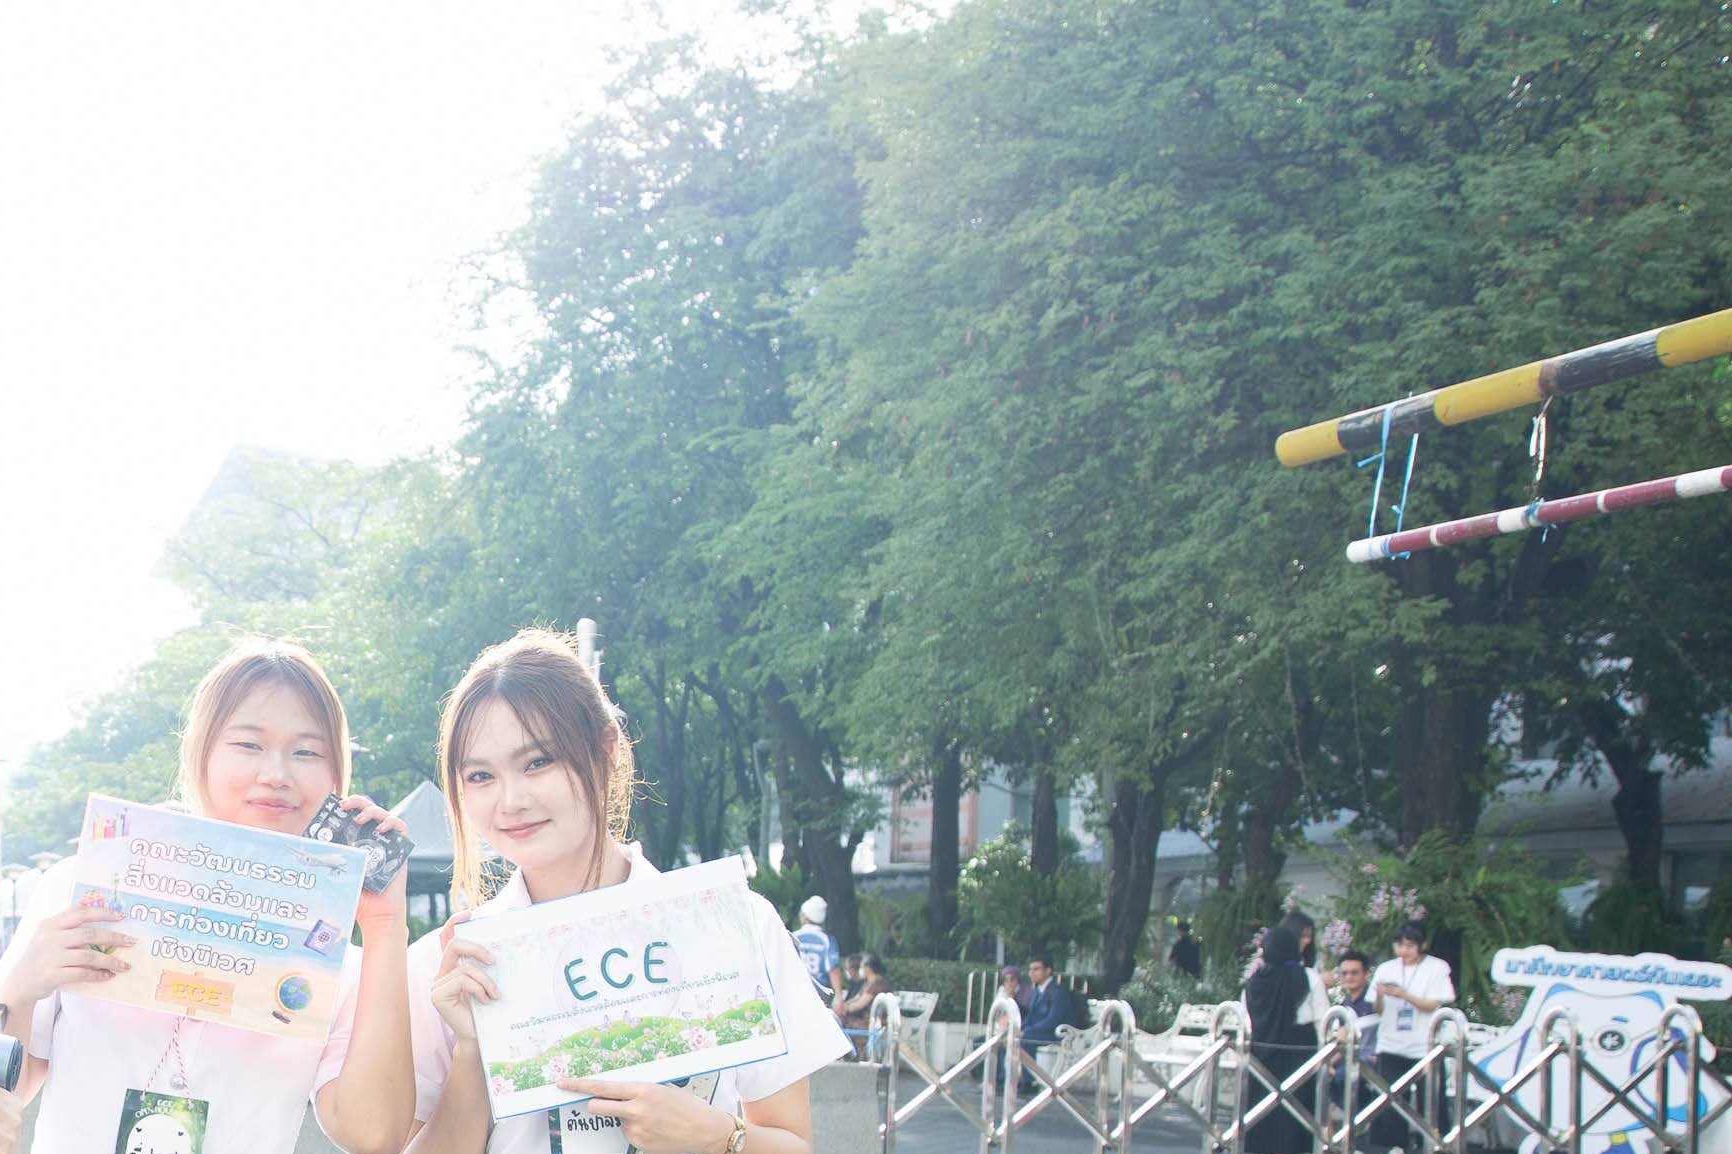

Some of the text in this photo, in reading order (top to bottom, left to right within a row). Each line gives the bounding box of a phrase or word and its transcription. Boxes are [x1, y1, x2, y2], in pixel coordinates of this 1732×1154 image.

[130, 838, 317, 889] คณะวัฒนธรรม
[125, 859, 309, 920] สิ่งแวดล้อมและ
[130, 907, 289, 949] การท่องเที่ยว
[151, 936, 256, 975] เชิงนิเวศ
[564, 941, 669, 1001] ECE
